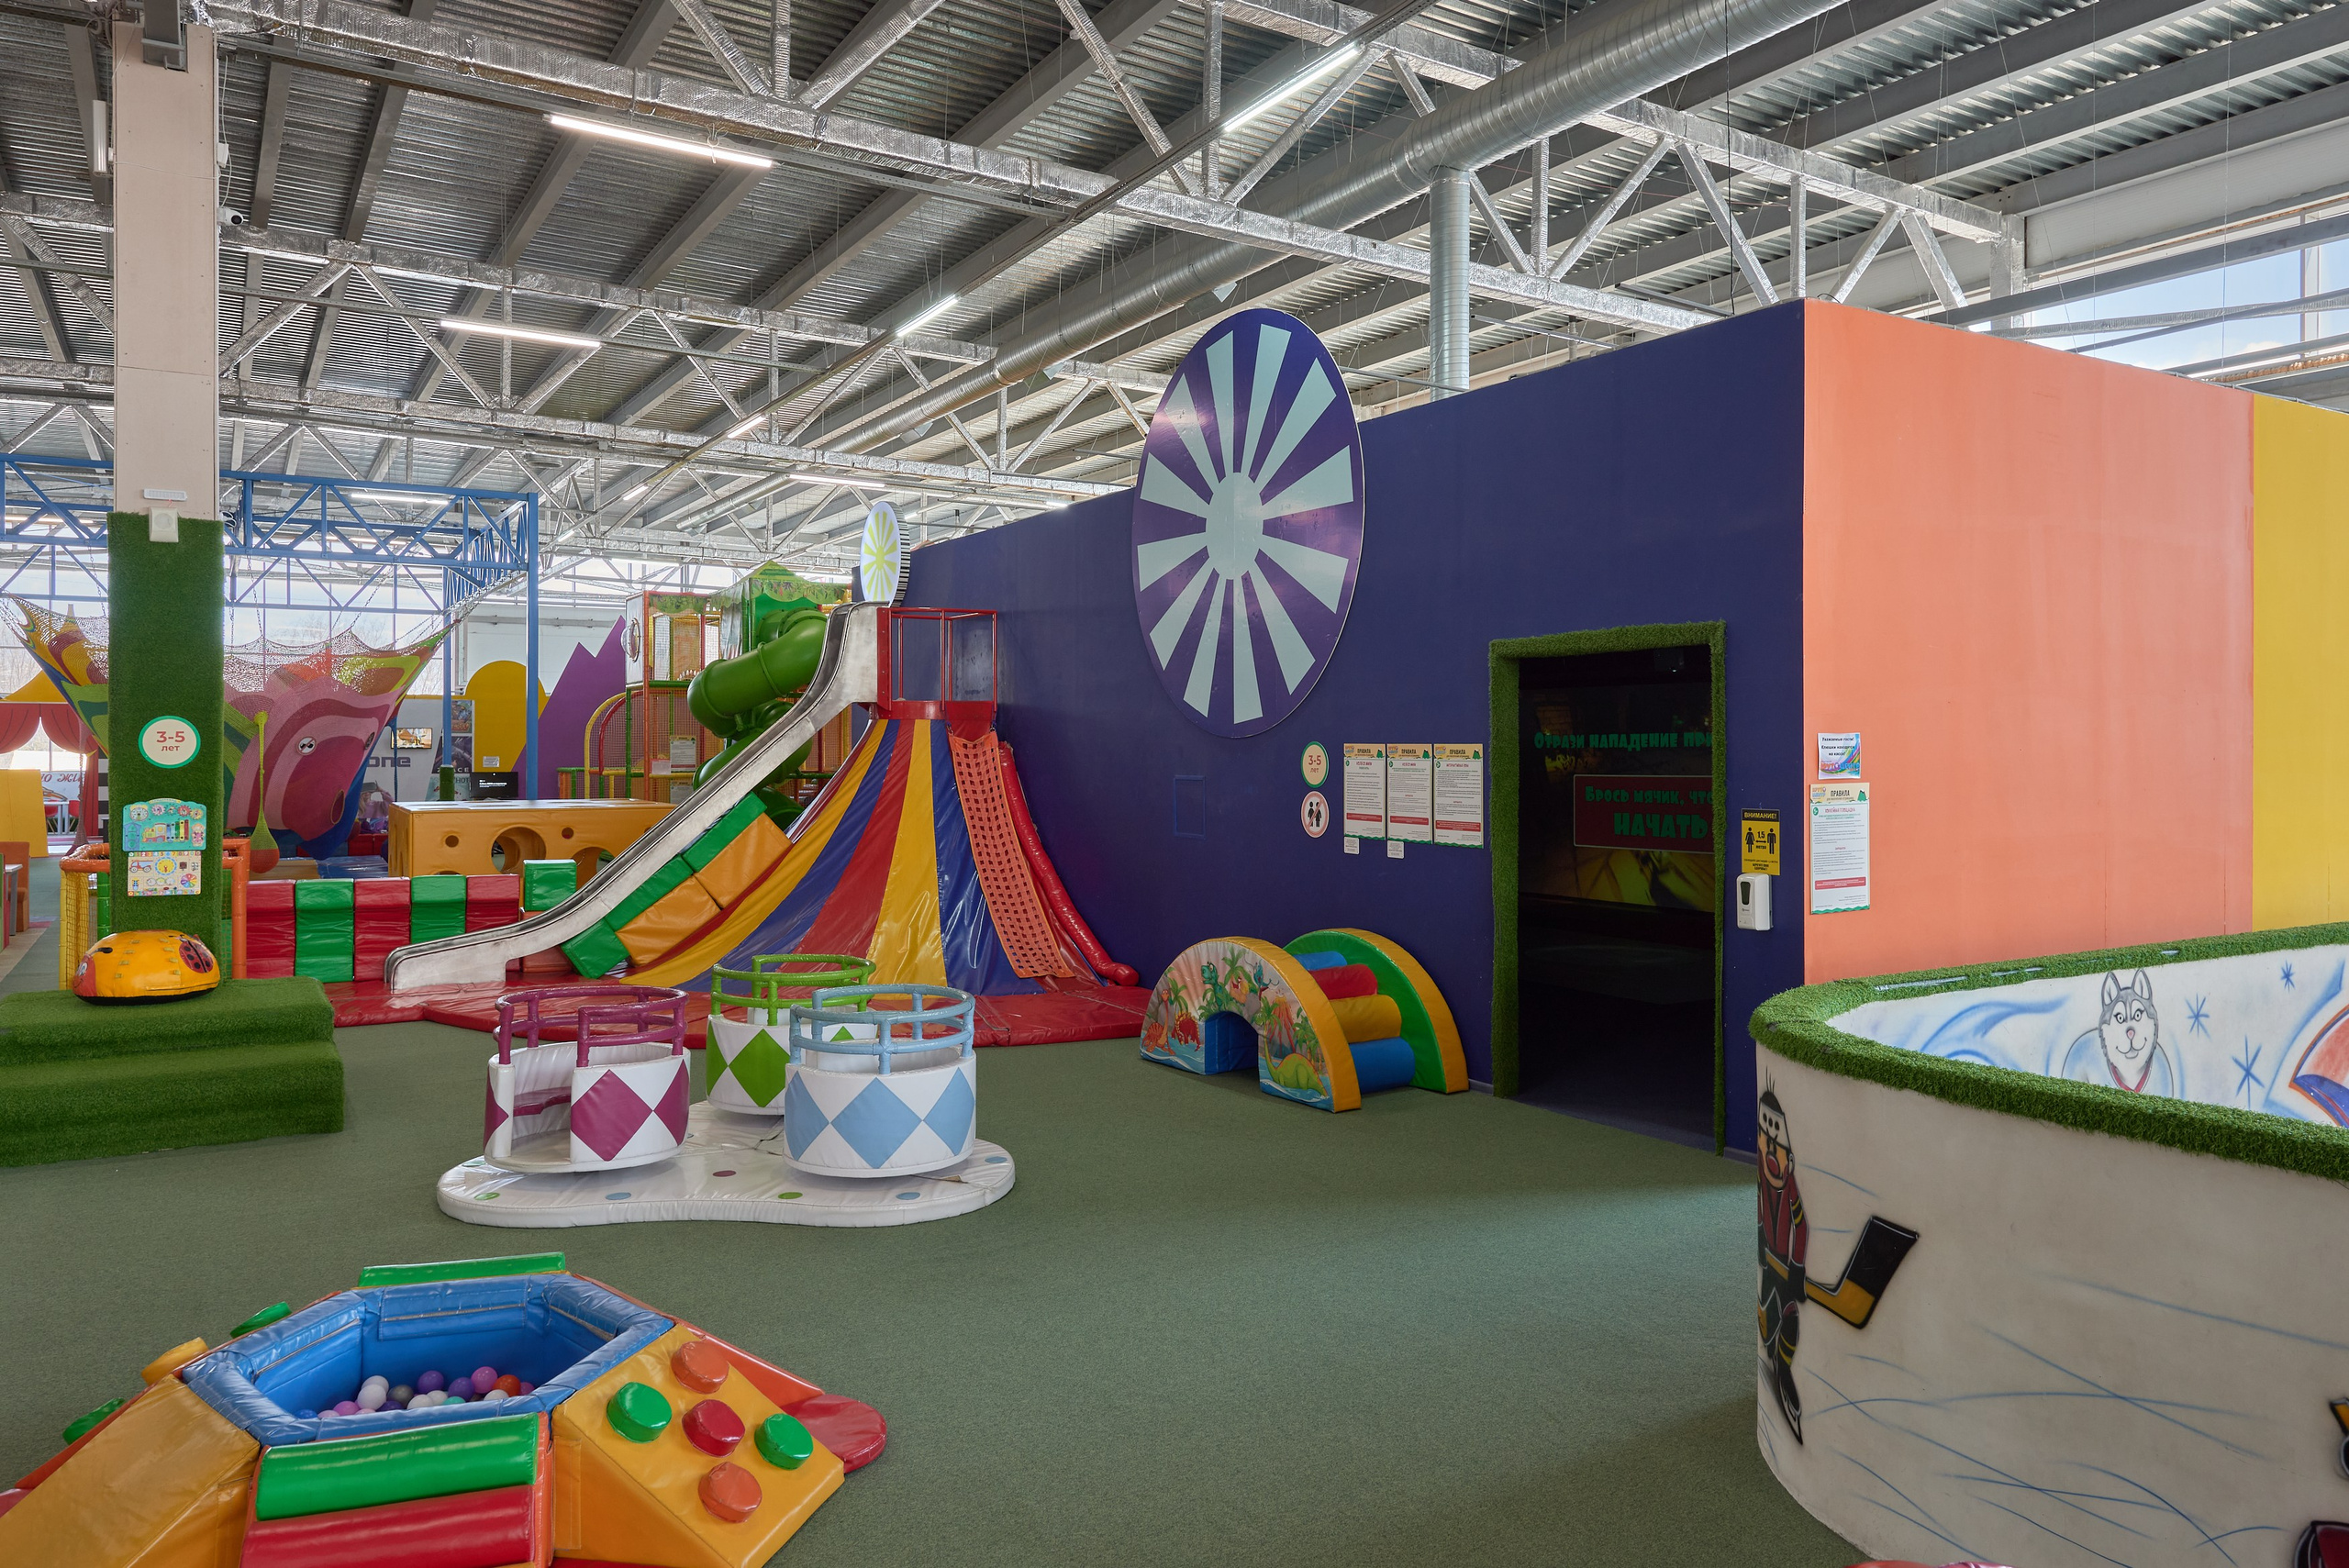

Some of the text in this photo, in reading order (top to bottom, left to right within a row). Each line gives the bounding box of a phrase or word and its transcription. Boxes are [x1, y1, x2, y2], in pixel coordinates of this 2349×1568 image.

[156, 730, 185, 743] 3-5
[1308, 755, 1321, 765] 3-5
[1613, 812, 1709, 839] НАЧАТЬ
